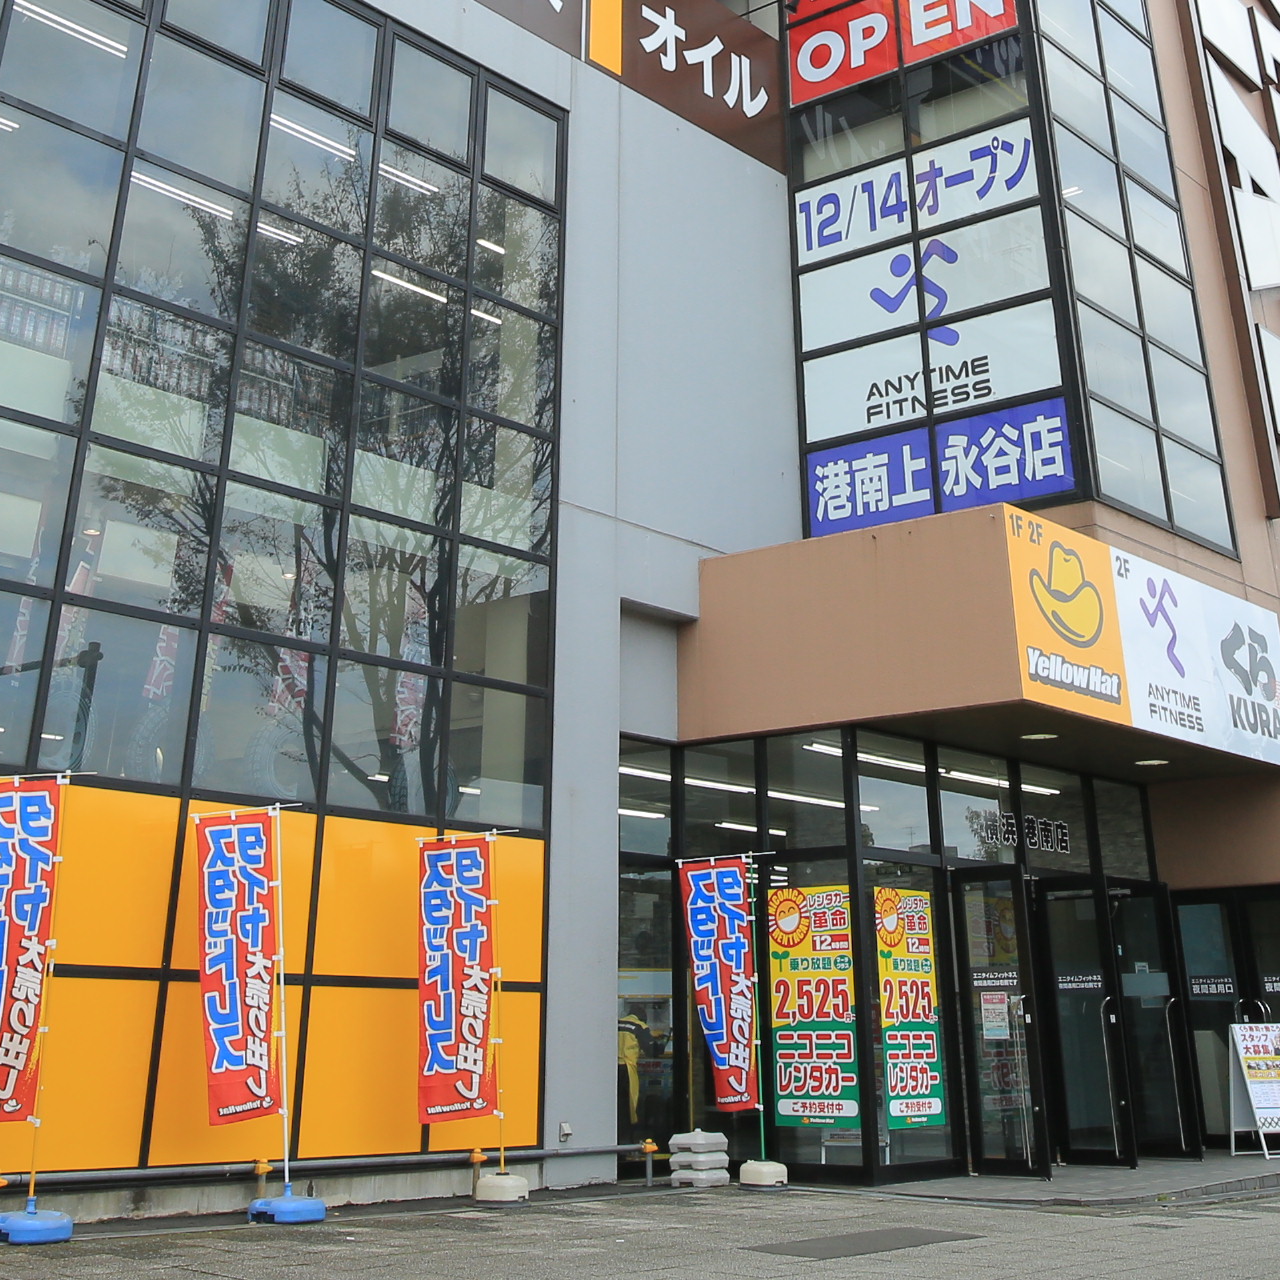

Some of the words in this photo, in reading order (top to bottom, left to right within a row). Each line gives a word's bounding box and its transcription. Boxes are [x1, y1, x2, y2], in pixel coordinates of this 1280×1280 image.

[641, 3, 768, 118] オイル
[866, 355, 990, 401] ANYTIME
[866, 378, 993, 424] FITNESS
[1009, 513, 1023, 538] 1F
[1027, 521, 1043, 545] 2F
[1115, 556, 1130, 579] 2F
[1026, 646, 1121, 704] YellowHat
[1220, 621, 1276, 701] くら
[1148, 683, 1200, 713] ANYTIME
[1149, 703, 1204, 732] FITNESS
[807, 892, 850, 908] レンタカー
[812, 910, 848, 931] 革命
[905, 913, 928, 934] 革命
[790, 958, 832, 970] 乗り放題
[1192, 984, 1234, 994] 夜間通用口
[777, 1031, 854, 1062] ニコニコ
[886, 1031, 937, 1062] ニコニコ
[1240, 1033, 1268, 1042] スタッフ
[777, 1063, 857, 1096] レンタカー
[888, 1063, 939, 1096] レンタカー
[792, 1101, 844, 1114] ご予約受付中
